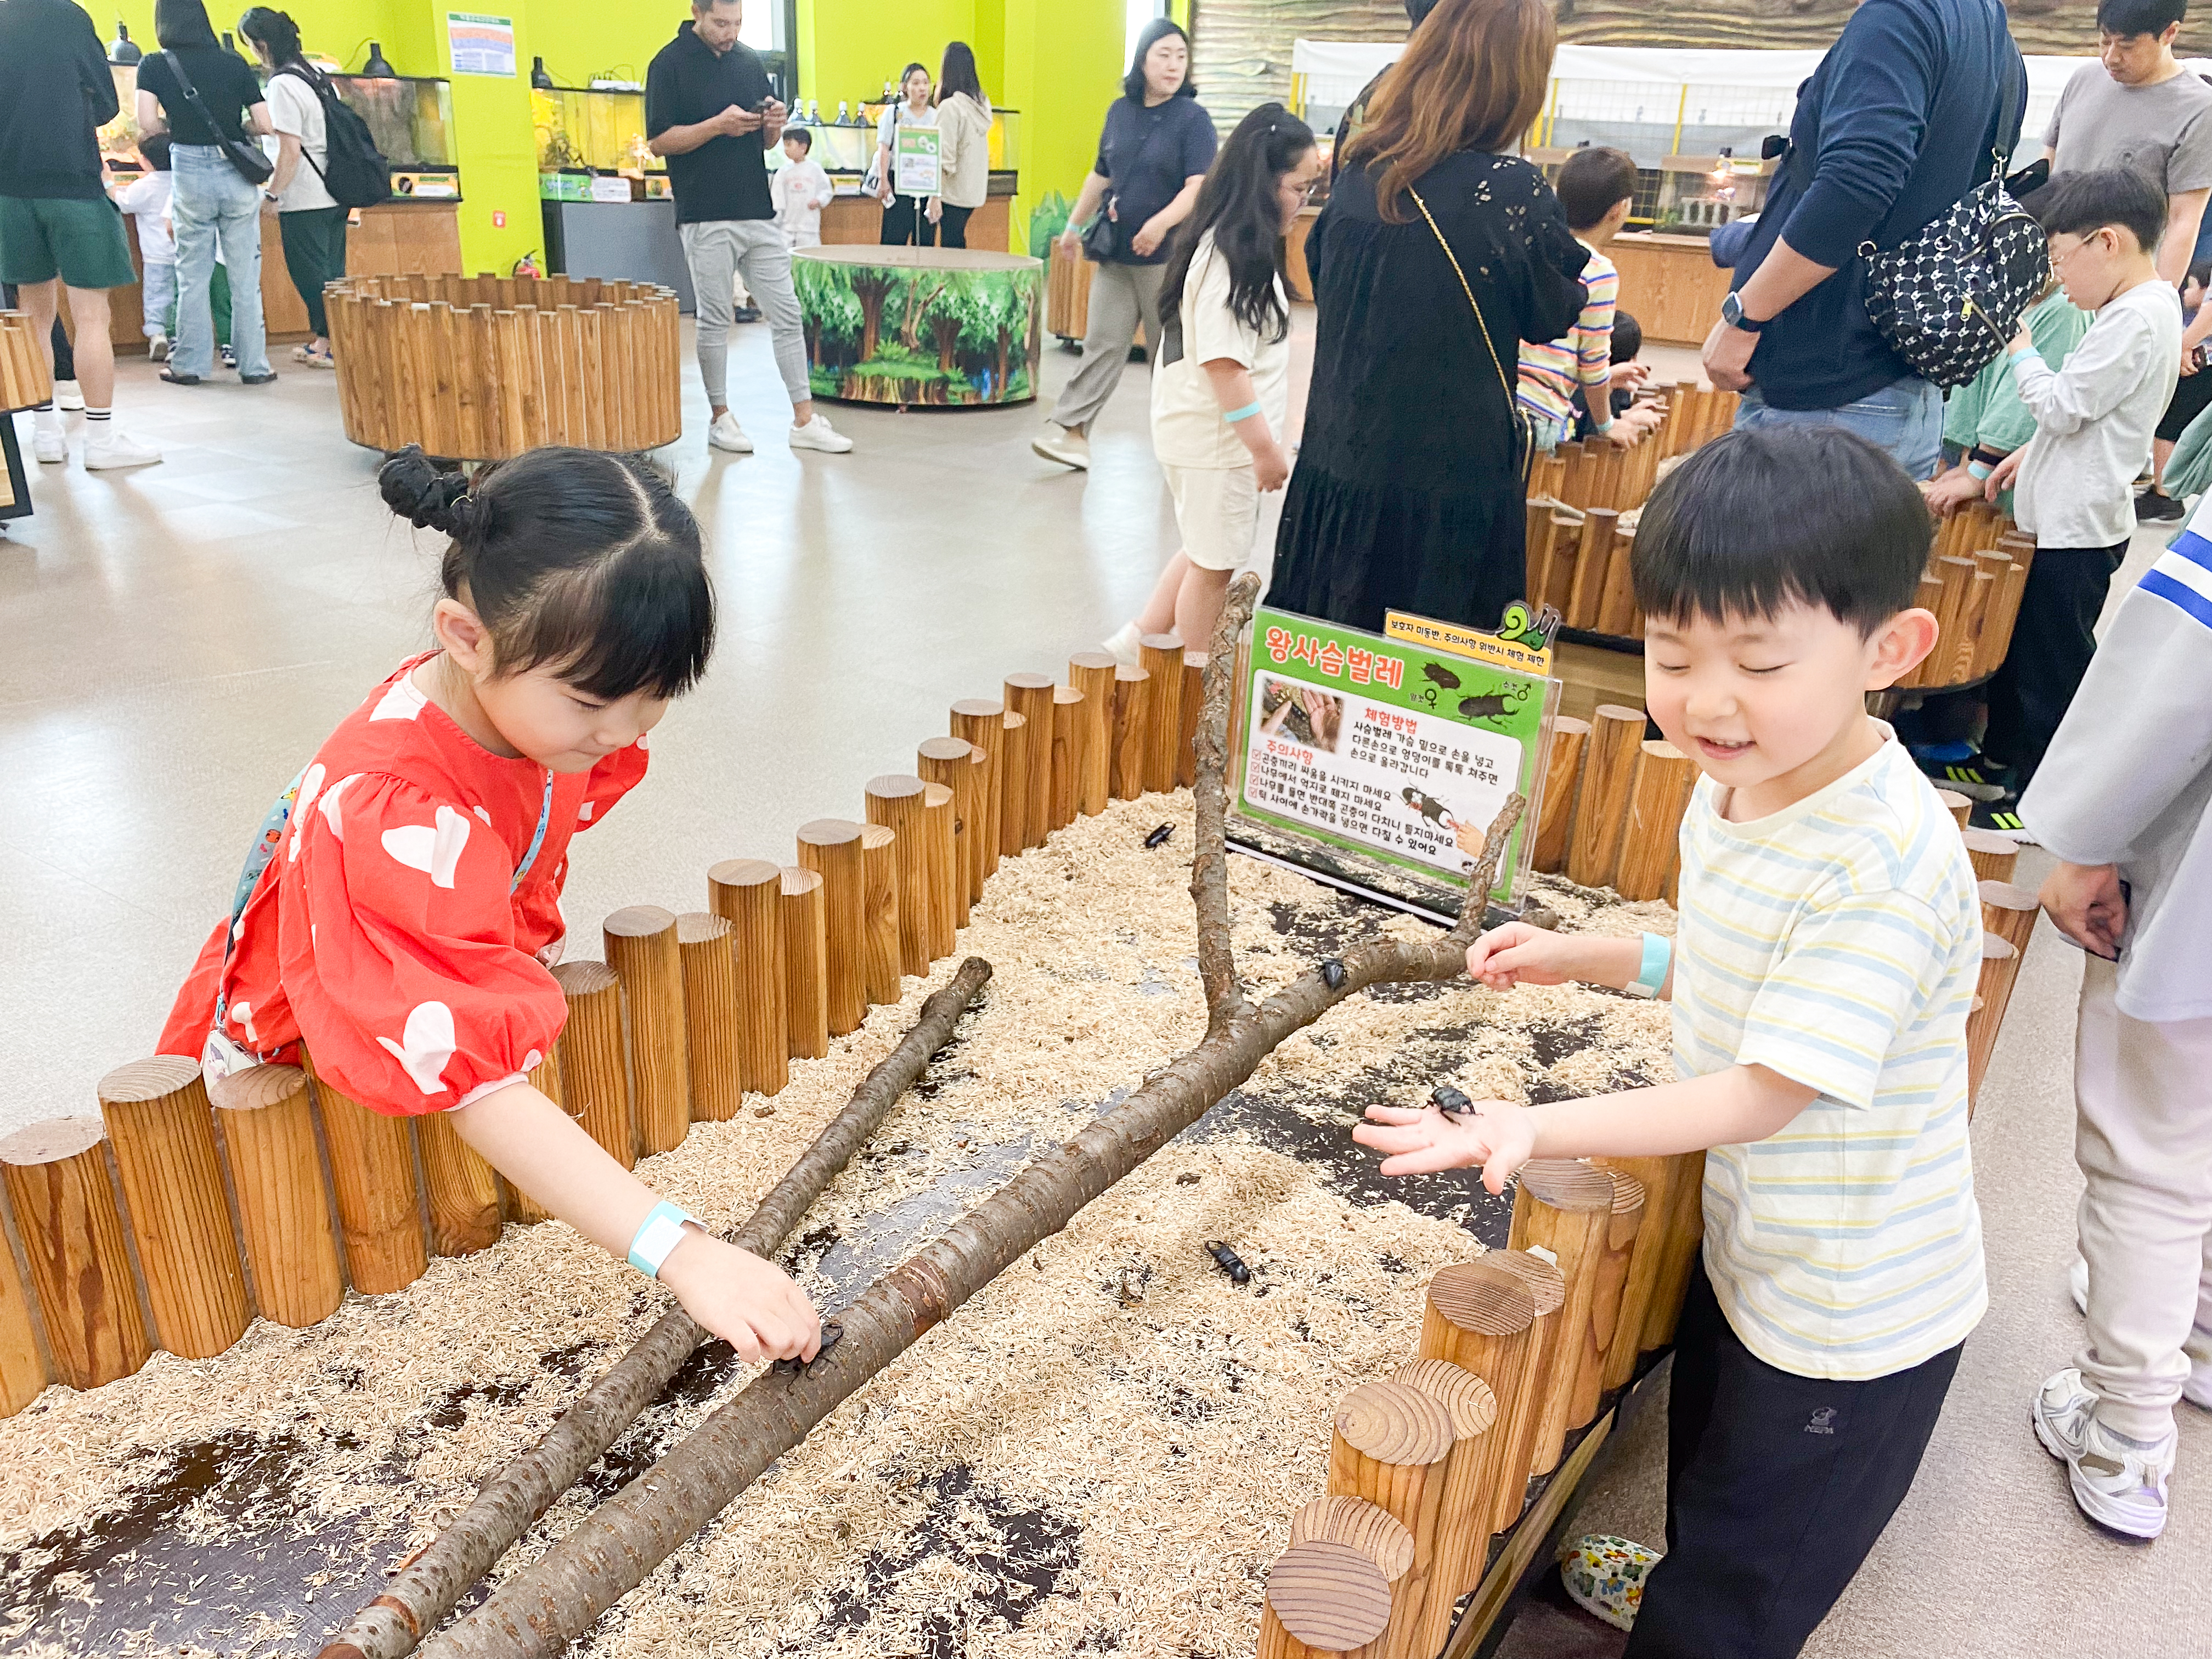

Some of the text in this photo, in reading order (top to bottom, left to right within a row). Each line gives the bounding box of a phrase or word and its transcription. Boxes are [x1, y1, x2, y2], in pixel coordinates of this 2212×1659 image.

[1266, 628, 1403, 689] 왕사슴벌레
[1391, 619, 1414, 633] 보호자
[1444, 633, 1477, 650] 주의사항
[1480, 642, 1504, 656] 위반시
[1507, 648, 1525, 662] 체험
[1527, 654, 1544, 667] 제한
[1353, 721, 1494, 769] 사슴벌레 가슴 밑으로 손을 넣고
[1364, 707, 1418, 735] 체험방법
[1262, 753, 1391, 801] 곤충끼리 싸움을 시키지 마세요
[1267, 740, 1313, 766] 주의사항
[1351, 747, 1429, 778] 손으로 올라갑니다
[1352, 735, 1397, 755] 다른손으로
[1402, 748, 1441, 769] 엉덩이를
[1444, 761, 1464, 775] 톡톡
[1261, 766, 1296, 784] 나무에서
[1300, 778, 1327, 794] 억지로
[1354, 795, 1381, 811] 마세요
[1260, 778, 1284, 794] 나무를
[1310, 793, 1336, 810] 반대쪽
[1340, 803, 1367, 820] 곤충이
[1372, 814, 1401, 830] 다치니
[1405, 824, 1453, 848] 들지마세요
[1271, 794, 1298, 810] 사이에
[1301, 804, 1336, 823] 손가락을
[1341, 816, 1368, 834] 넣으면
[1372, 827, 1391, 842] 다칠
[1395, 834, 1403, 844] 수
[1408, 838, 1436, 855] 있어요
